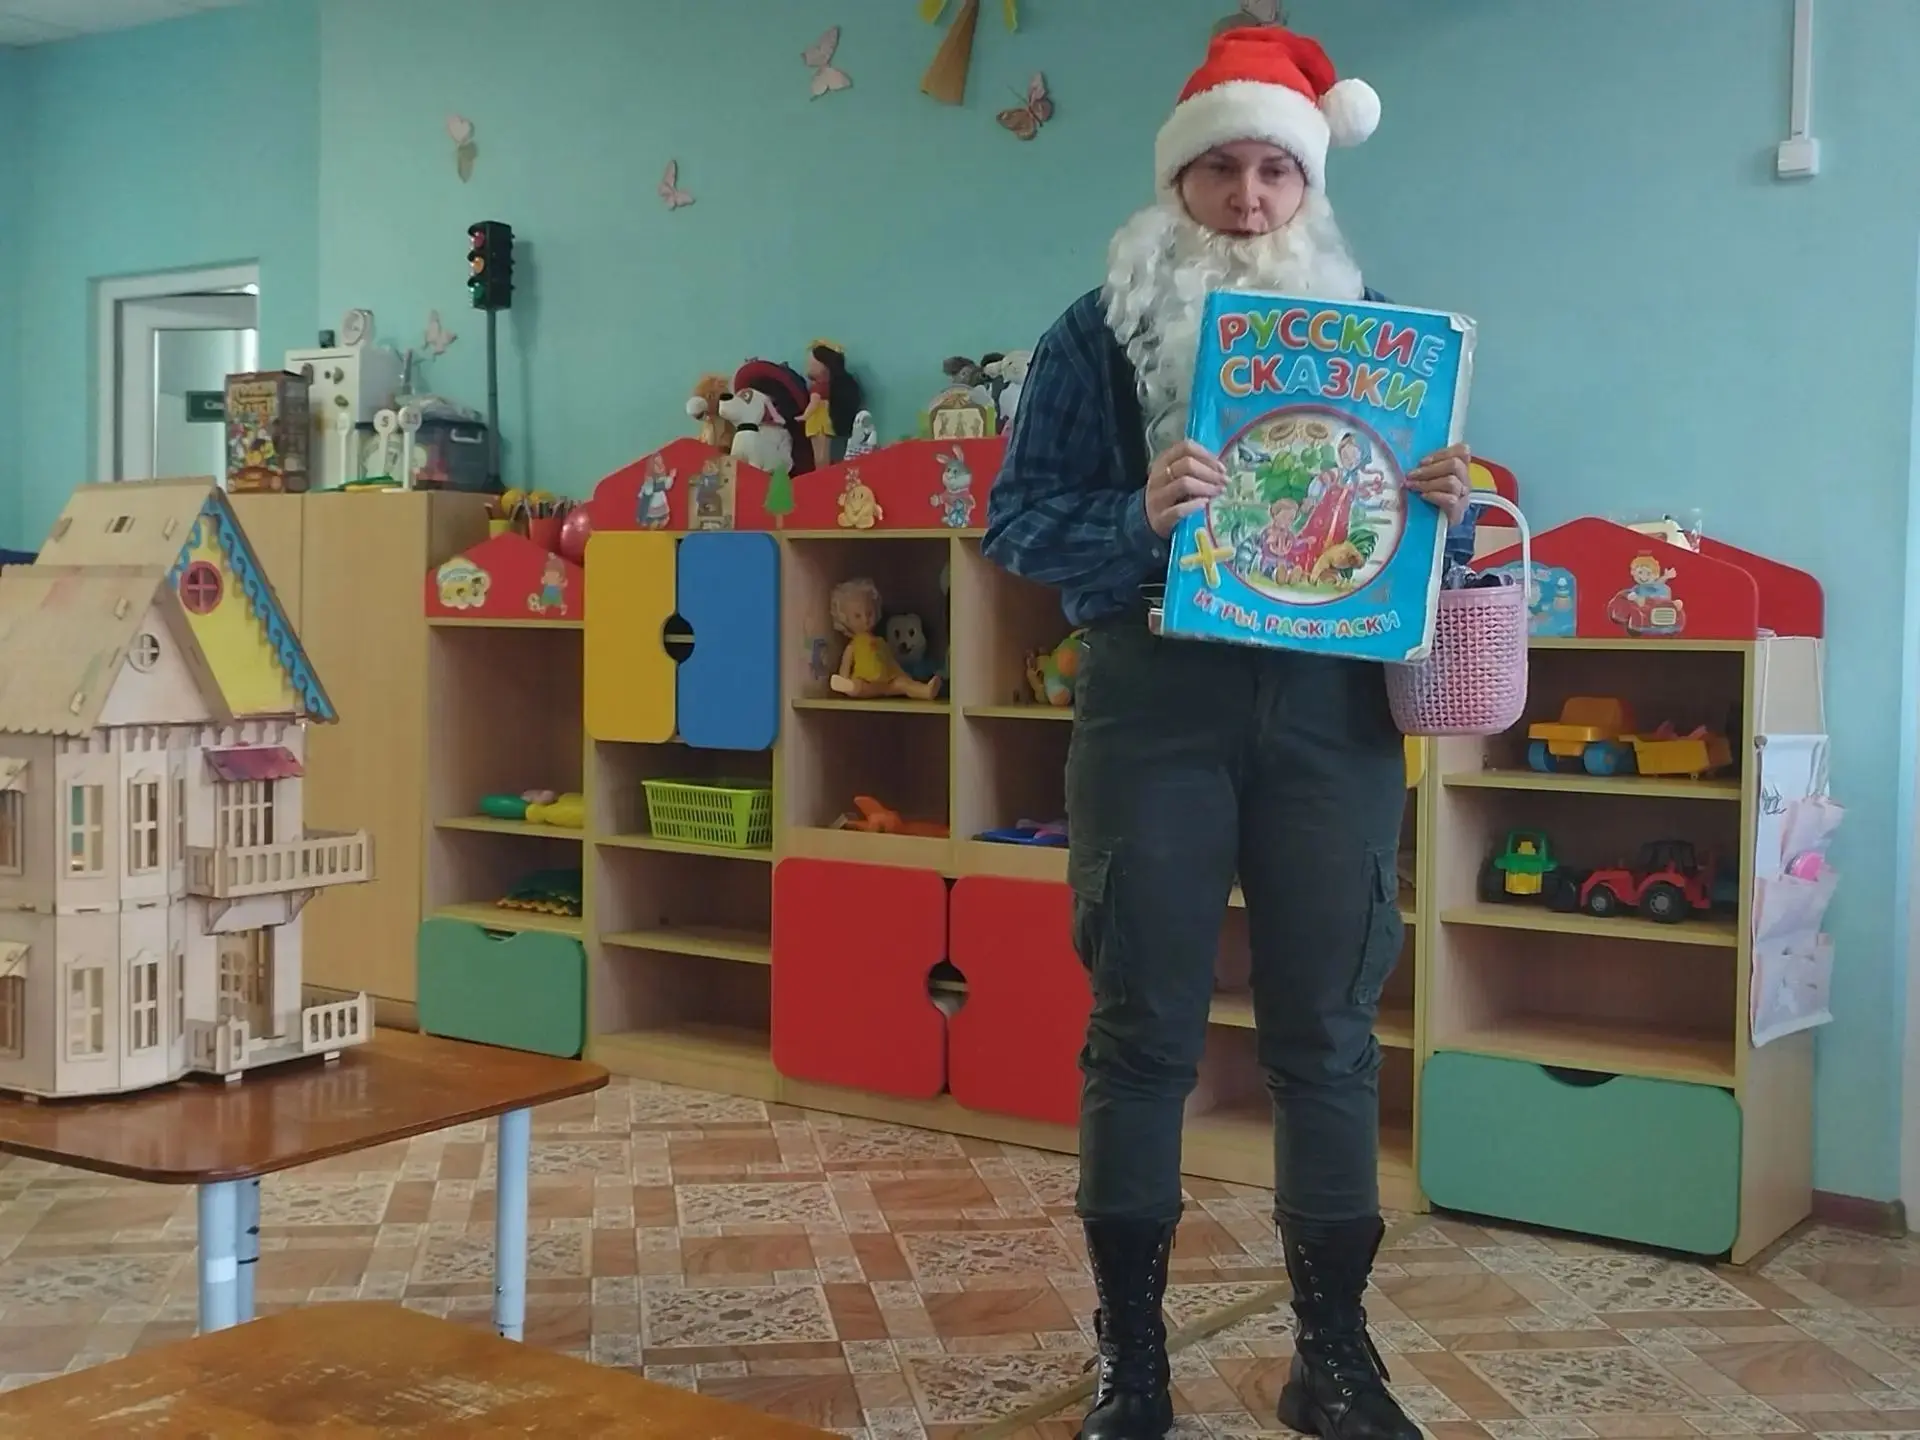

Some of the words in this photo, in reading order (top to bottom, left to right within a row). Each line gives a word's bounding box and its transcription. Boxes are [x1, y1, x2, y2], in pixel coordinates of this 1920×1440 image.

[1217, 308, 1446, 378] РУССКИЕ
[1219, 353, 1428, 419] СКАЗКИ
[1264, 609, 1401, 639] РАСКРАСКИ
